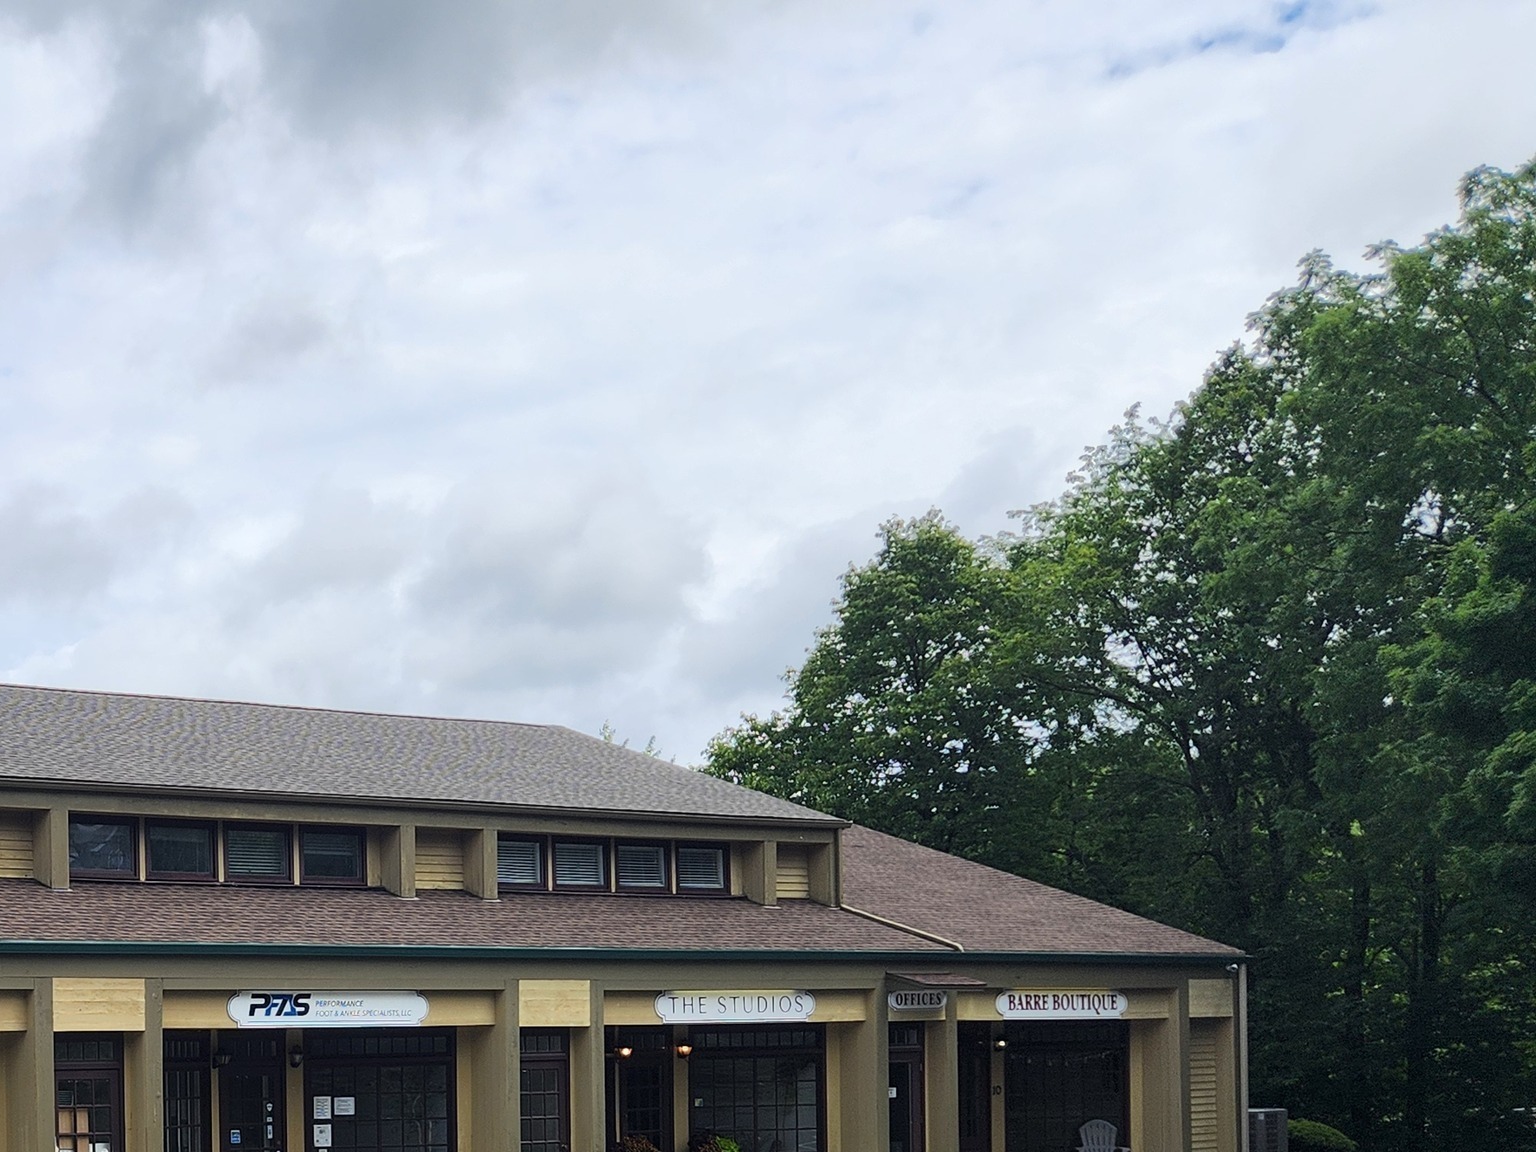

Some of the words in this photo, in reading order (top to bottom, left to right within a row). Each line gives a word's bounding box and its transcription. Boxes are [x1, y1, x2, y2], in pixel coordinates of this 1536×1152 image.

[668, 997, 707, 1014] THE
[717, 995, 804, 1014] STUDIOS
[895, 992, 943, 1006] OFFICES
[1008, 994, 1050, 1010] BARRE
[1053, 993, 1118, 1015] BOUTIQUE
[315, 1010, 334, 1018] FOOT
[362, 1009, 400, 1017] SPECIALISTS,
[401, 1009, 412, 1017] LLC
